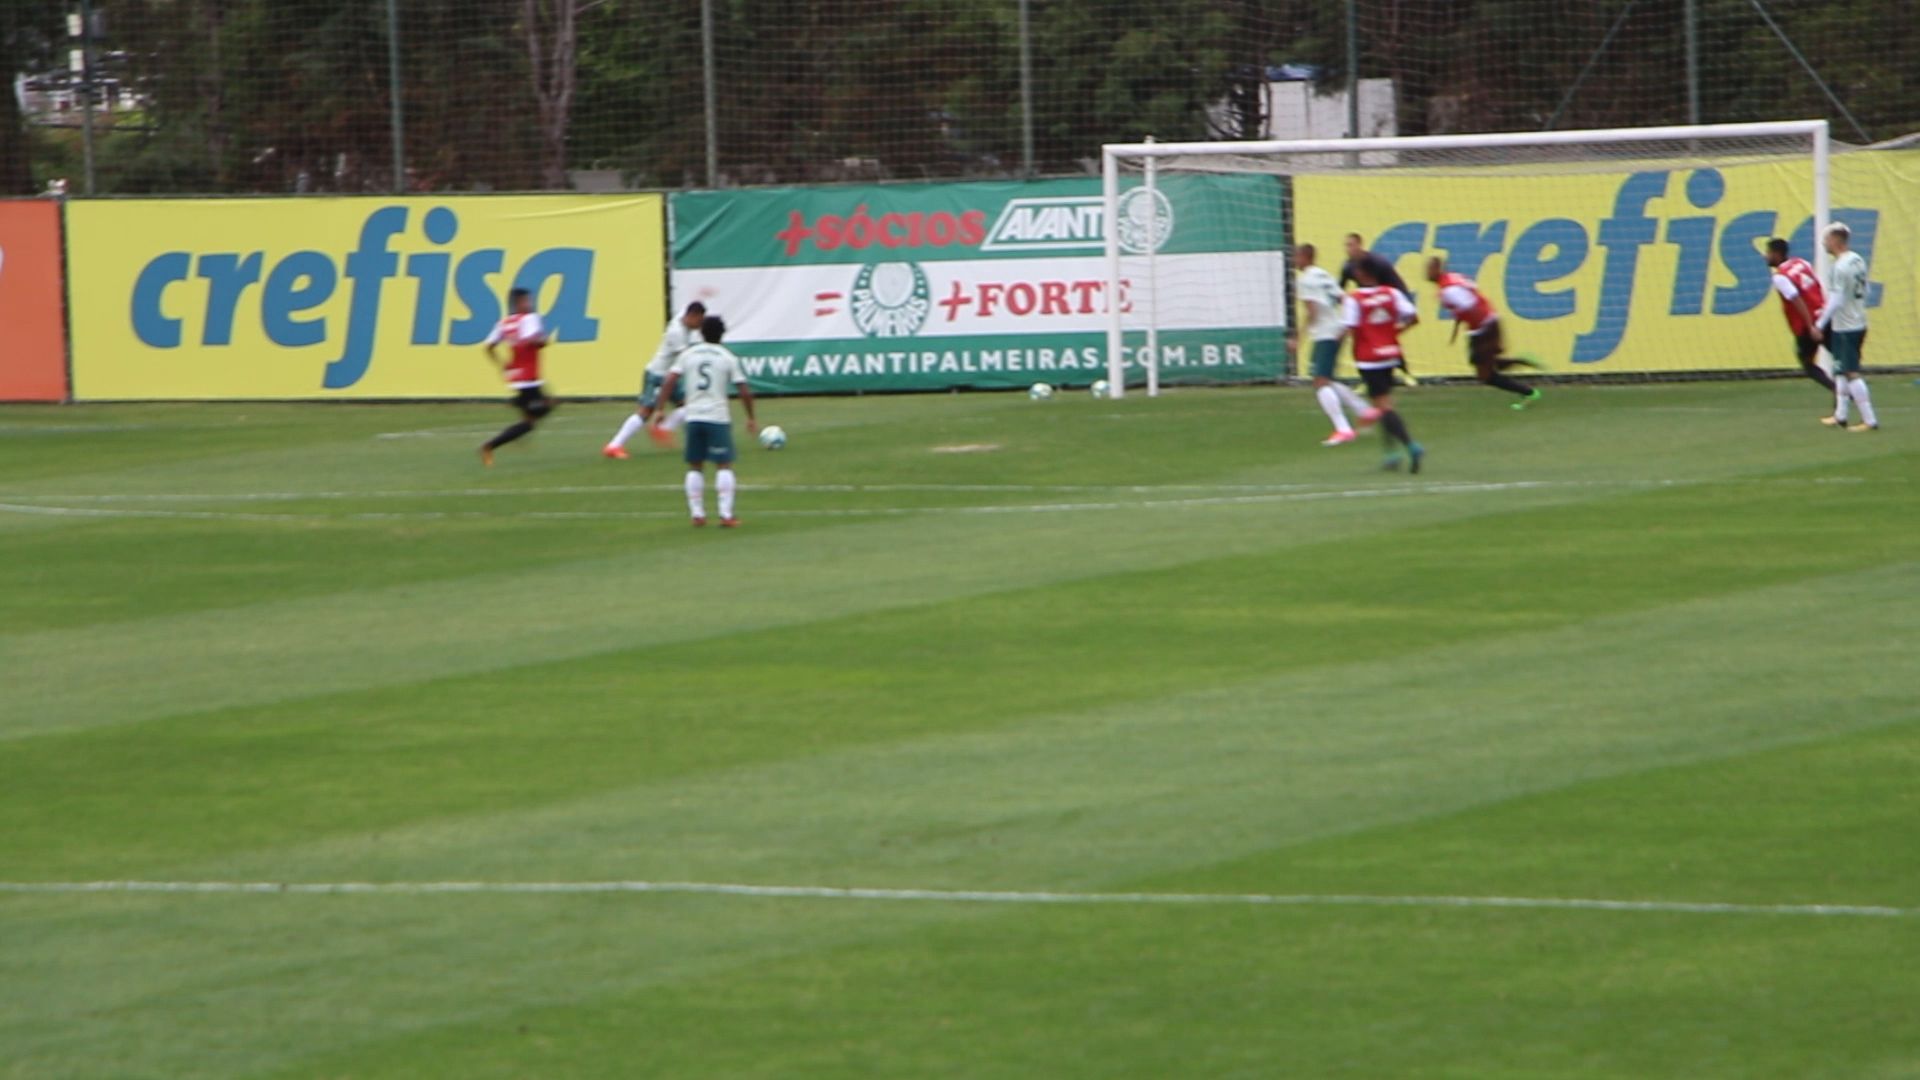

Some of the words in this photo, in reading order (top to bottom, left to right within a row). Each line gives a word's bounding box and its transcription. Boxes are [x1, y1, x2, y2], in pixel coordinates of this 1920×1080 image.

[130, 205, 599, 389] crefisa
[696, 361, 712, 391] 5
[738, 343, 1246, 379] WW.AVANTIPALMEIRAS.COM.BR
